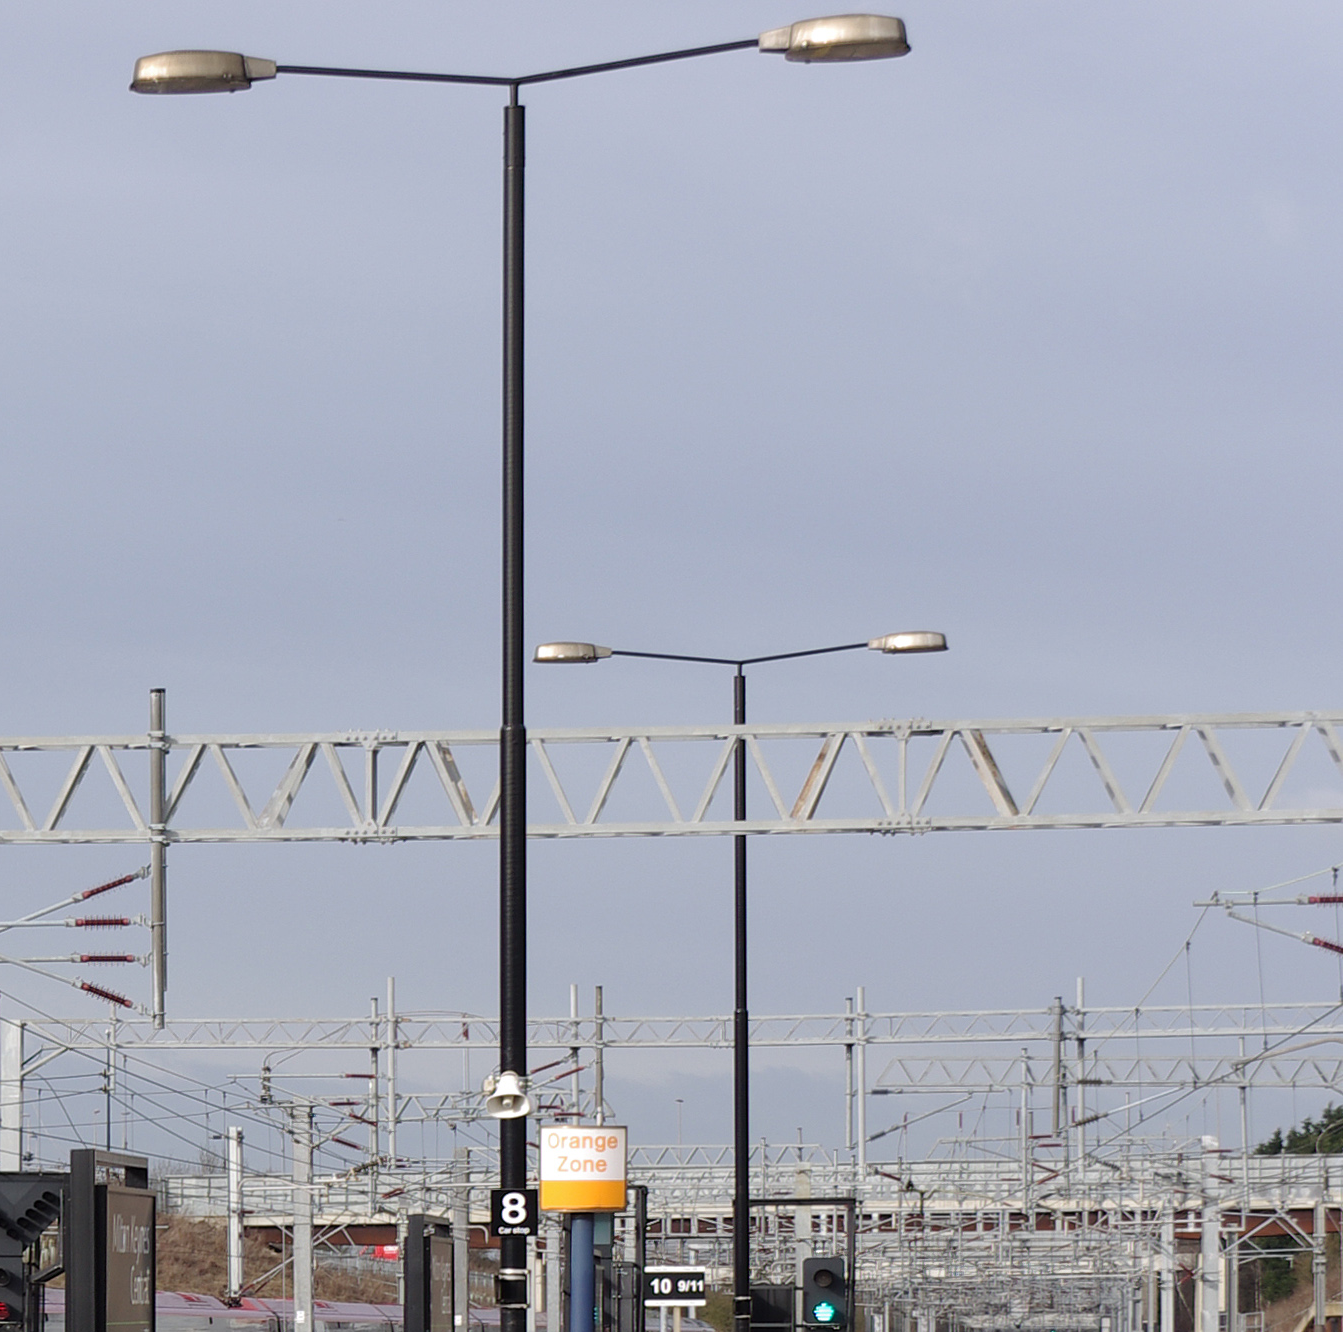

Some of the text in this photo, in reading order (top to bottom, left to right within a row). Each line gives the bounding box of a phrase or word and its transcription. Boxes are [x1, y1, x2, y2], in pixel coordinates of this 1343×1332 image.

[548, 1132, 618, 1153] Orange
[557, 1155, 607, 1173] Zone
[501, 1192, 527, 1225] 8
[650, 1278, 704, 1294] 10 9/11
